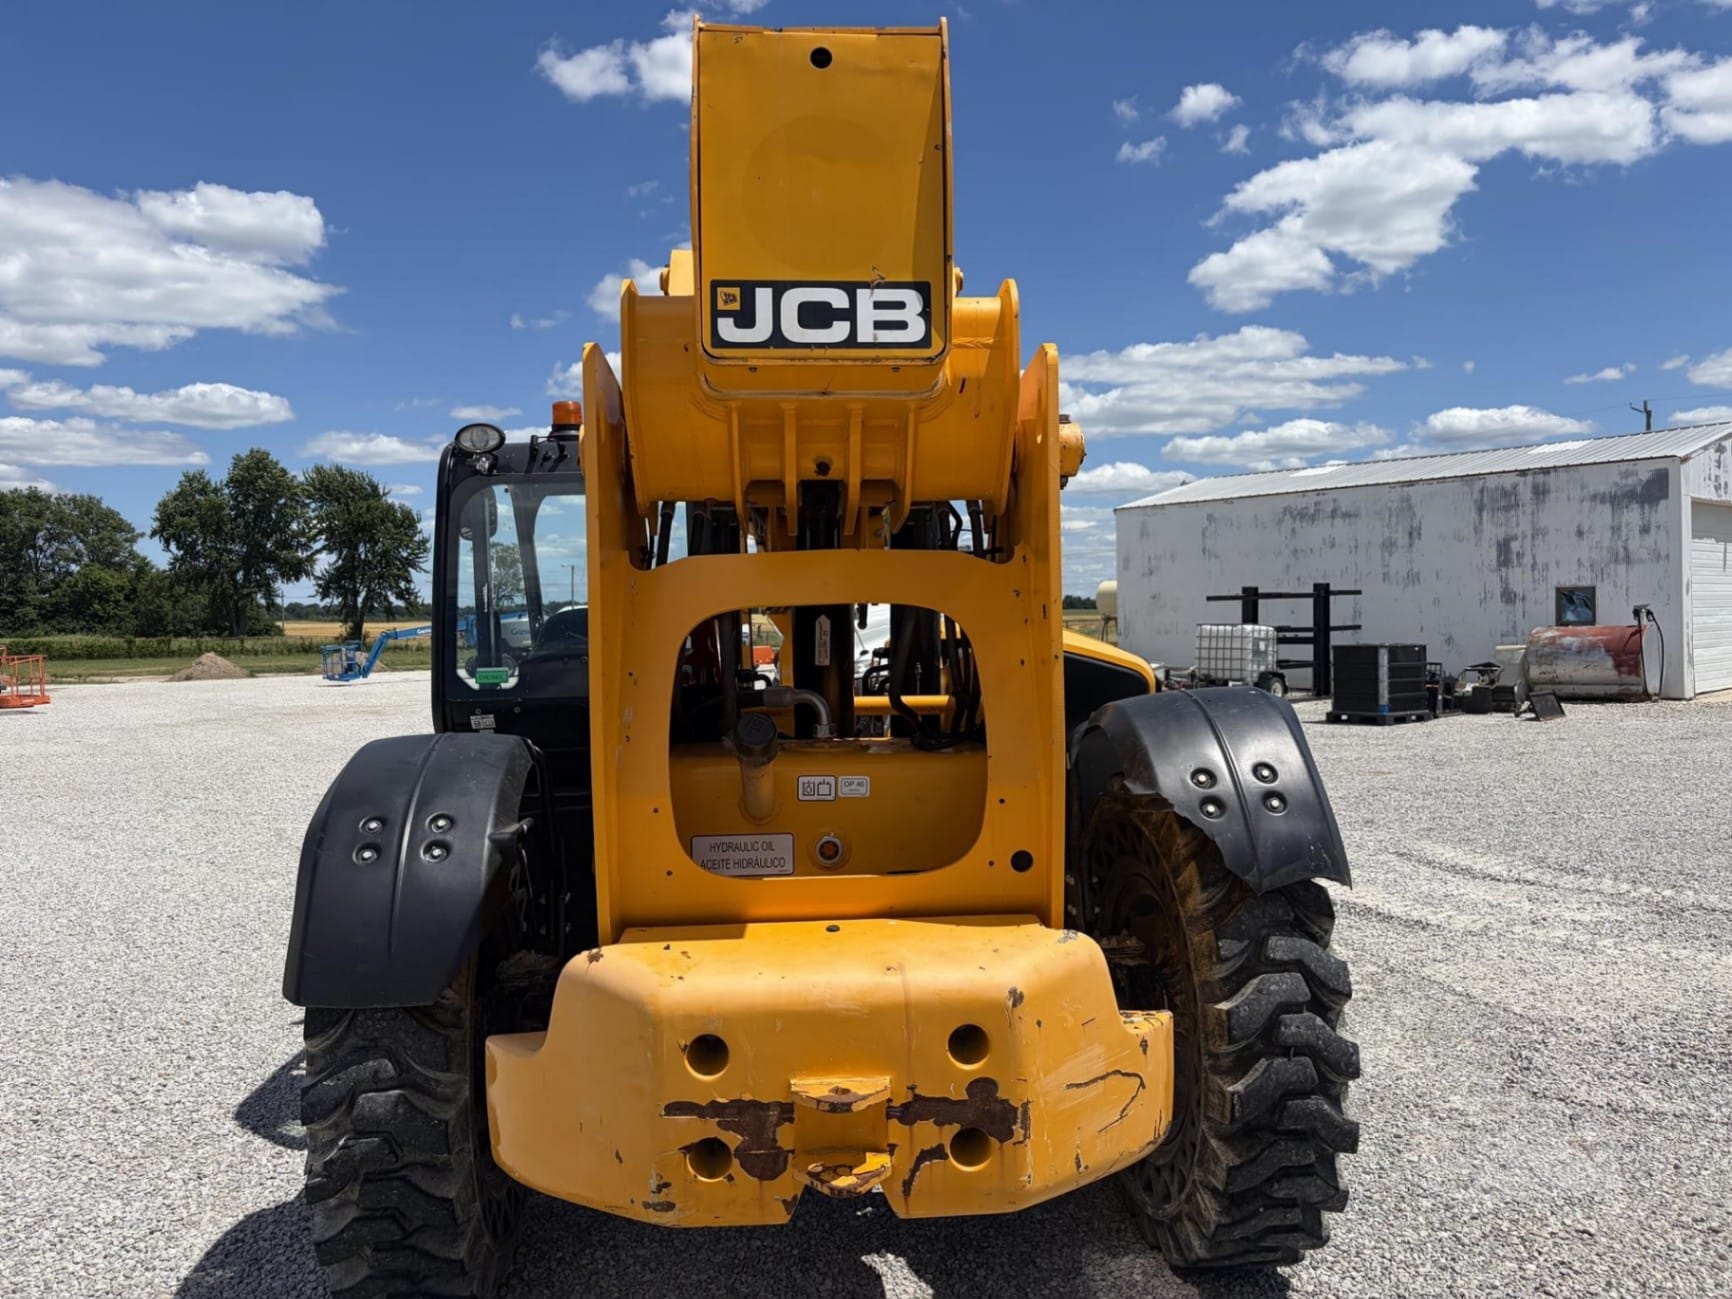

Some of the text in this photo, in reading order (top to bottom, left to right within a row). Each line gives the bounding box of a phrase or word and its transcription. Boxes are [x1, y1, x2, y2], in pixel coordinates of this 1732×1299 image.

[717, 287, 926, 343] JCB
[709, 840, 776, 853] HYDRAULIC OIL
[701, 856, 786, 870] ACEITE HIDRÁULICO
